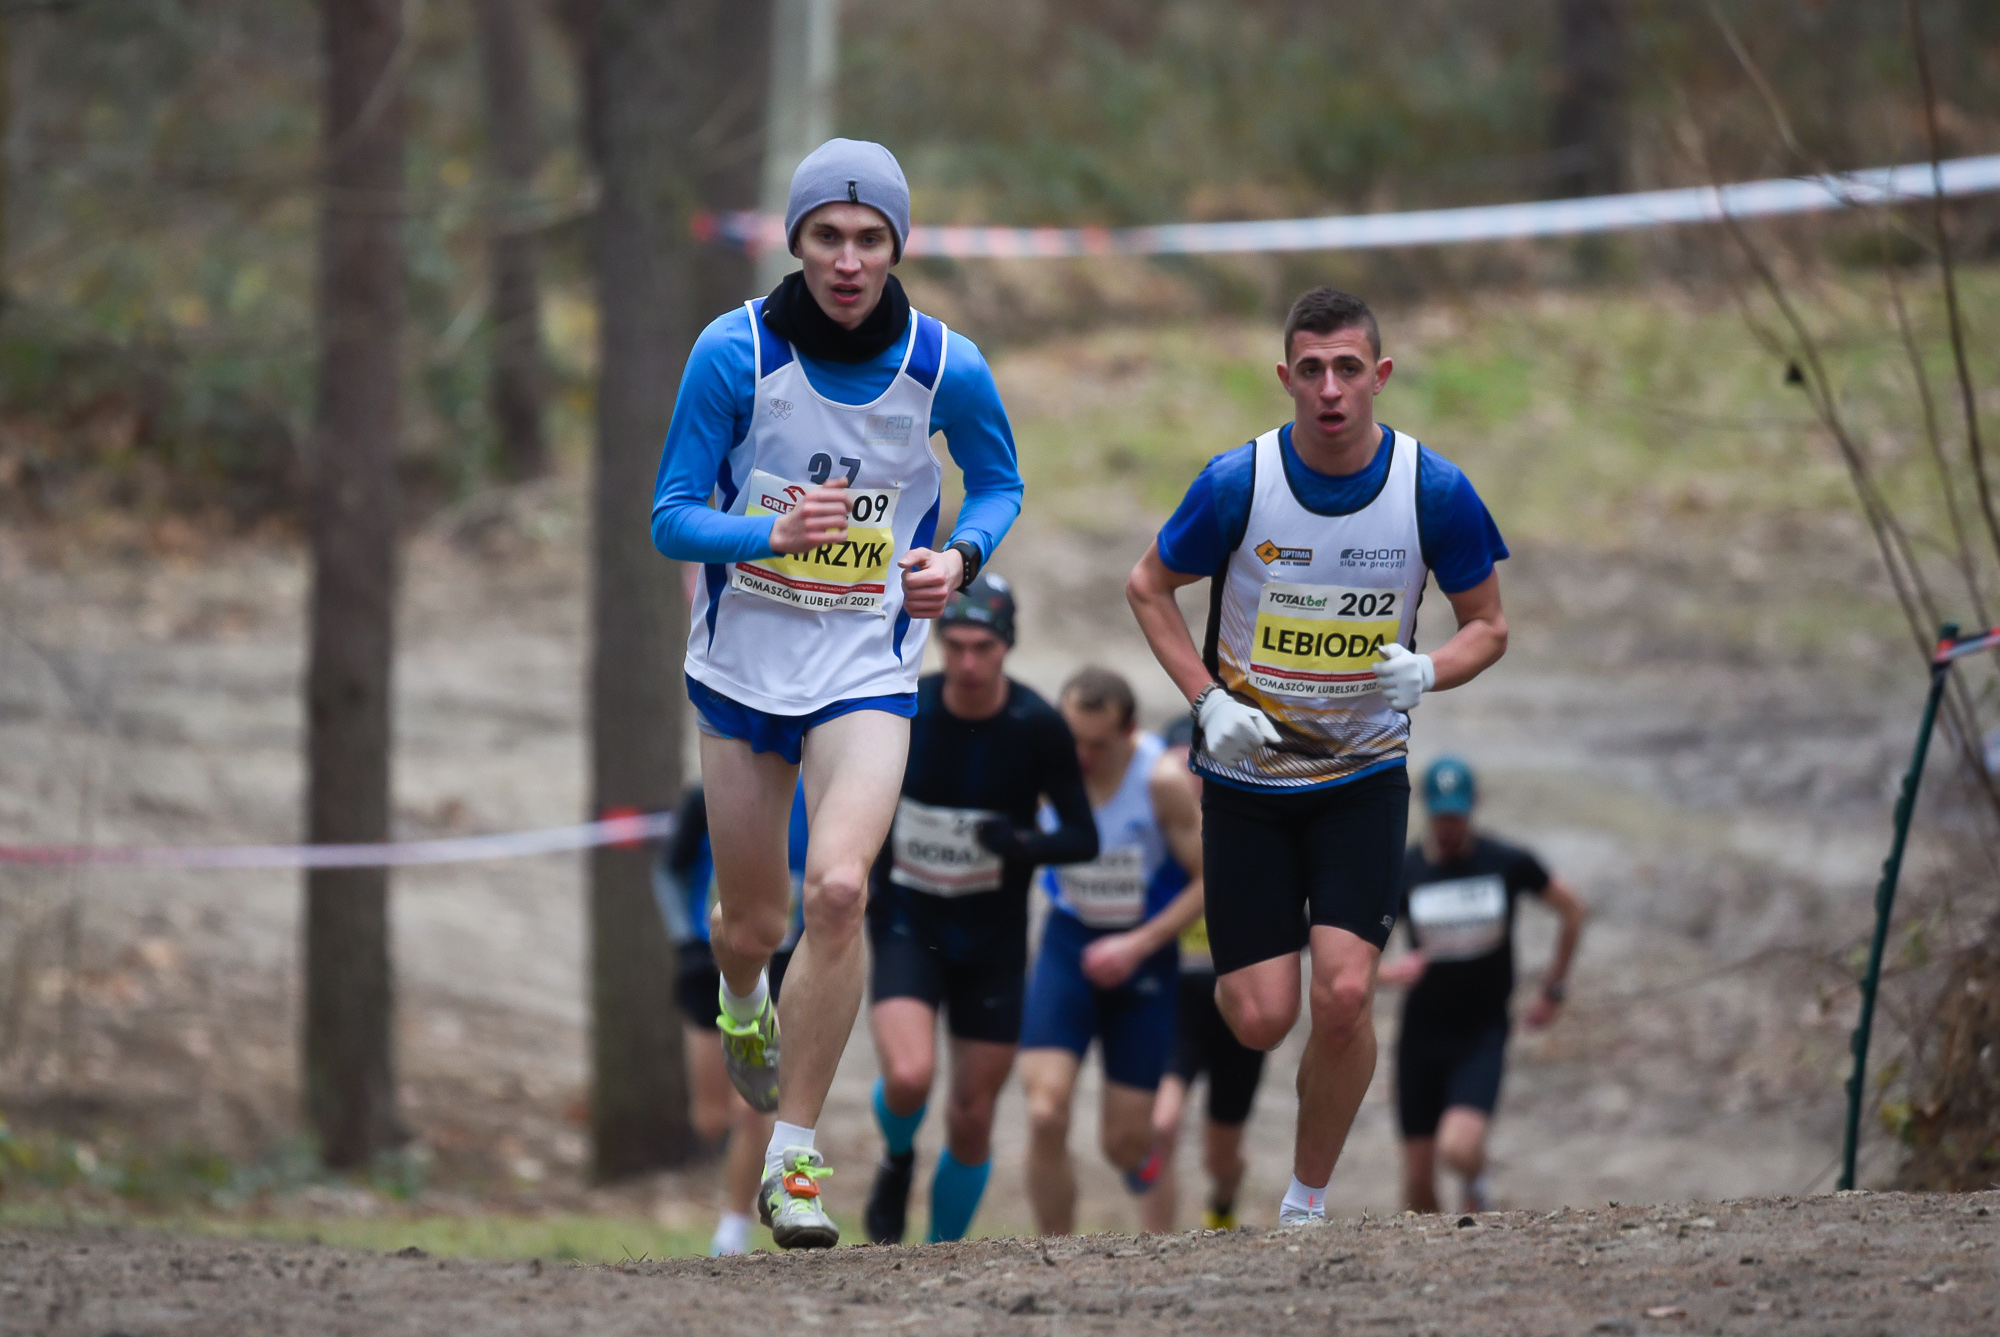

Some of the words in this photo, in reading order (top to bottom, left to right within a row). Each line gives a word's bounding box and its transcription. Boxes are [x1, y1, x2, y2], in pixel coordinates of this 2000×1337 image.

[763, 496, 796, 514] ORLE
[847, 494, 889, 523] 09
[1280, 550, 1310, 559] OPTIMA
[739, 574, 801, 603] TOMASZÓW
[850, 596, 875, 607] 2021
[1337, 592, 1396, 617] 202
[1262, 626, 1386, 659] LEBIODA
[1255, 676, 1315, 693] TOMASZÓW
[1317, 684, 1360, 694] LUBELSKI
